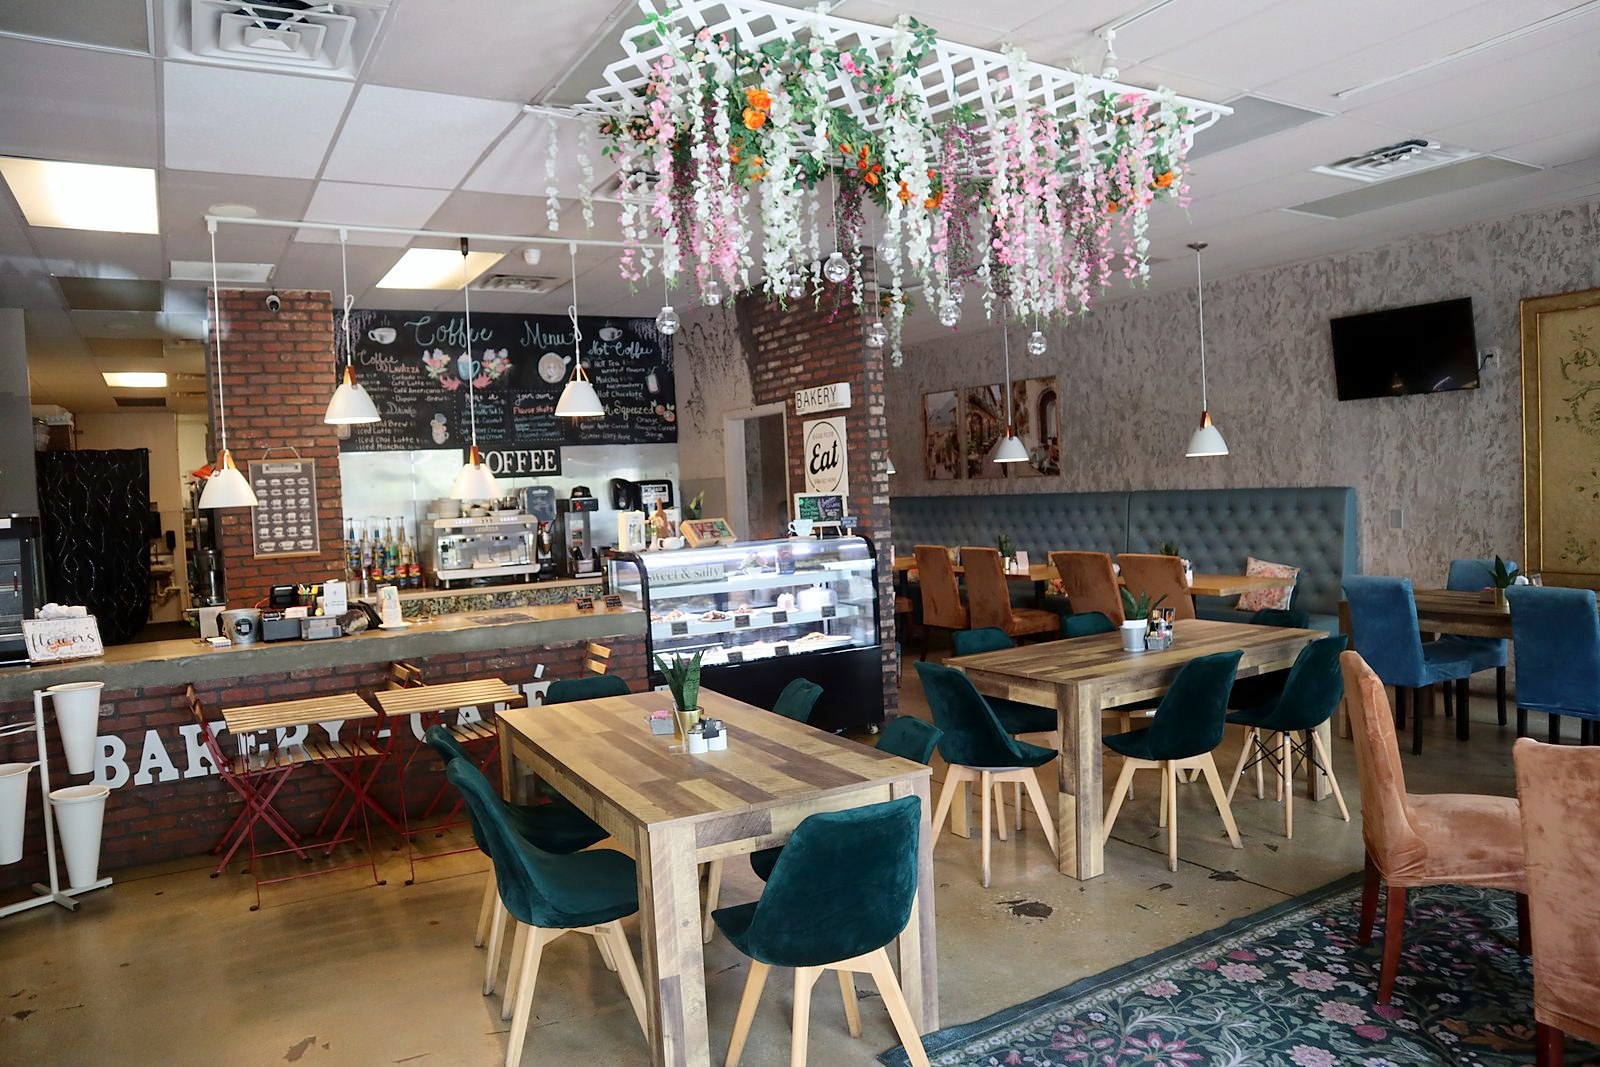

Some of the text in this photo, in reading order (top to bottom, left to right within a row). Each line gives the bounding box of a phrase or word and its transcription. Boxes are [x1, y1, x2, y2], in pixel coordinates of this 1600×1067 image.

[404, 316, 576, 350] Coffee Menu
[357, 350, 399, 372] Coffee
[611, 341, 653, 359] Coffee
[796, 385, 837, 409] BAKERY
[810, 440, 839, 475] Eat
[648, 563, 719, 582] sweet & salty
[32, 633, 95, 653] flowers
